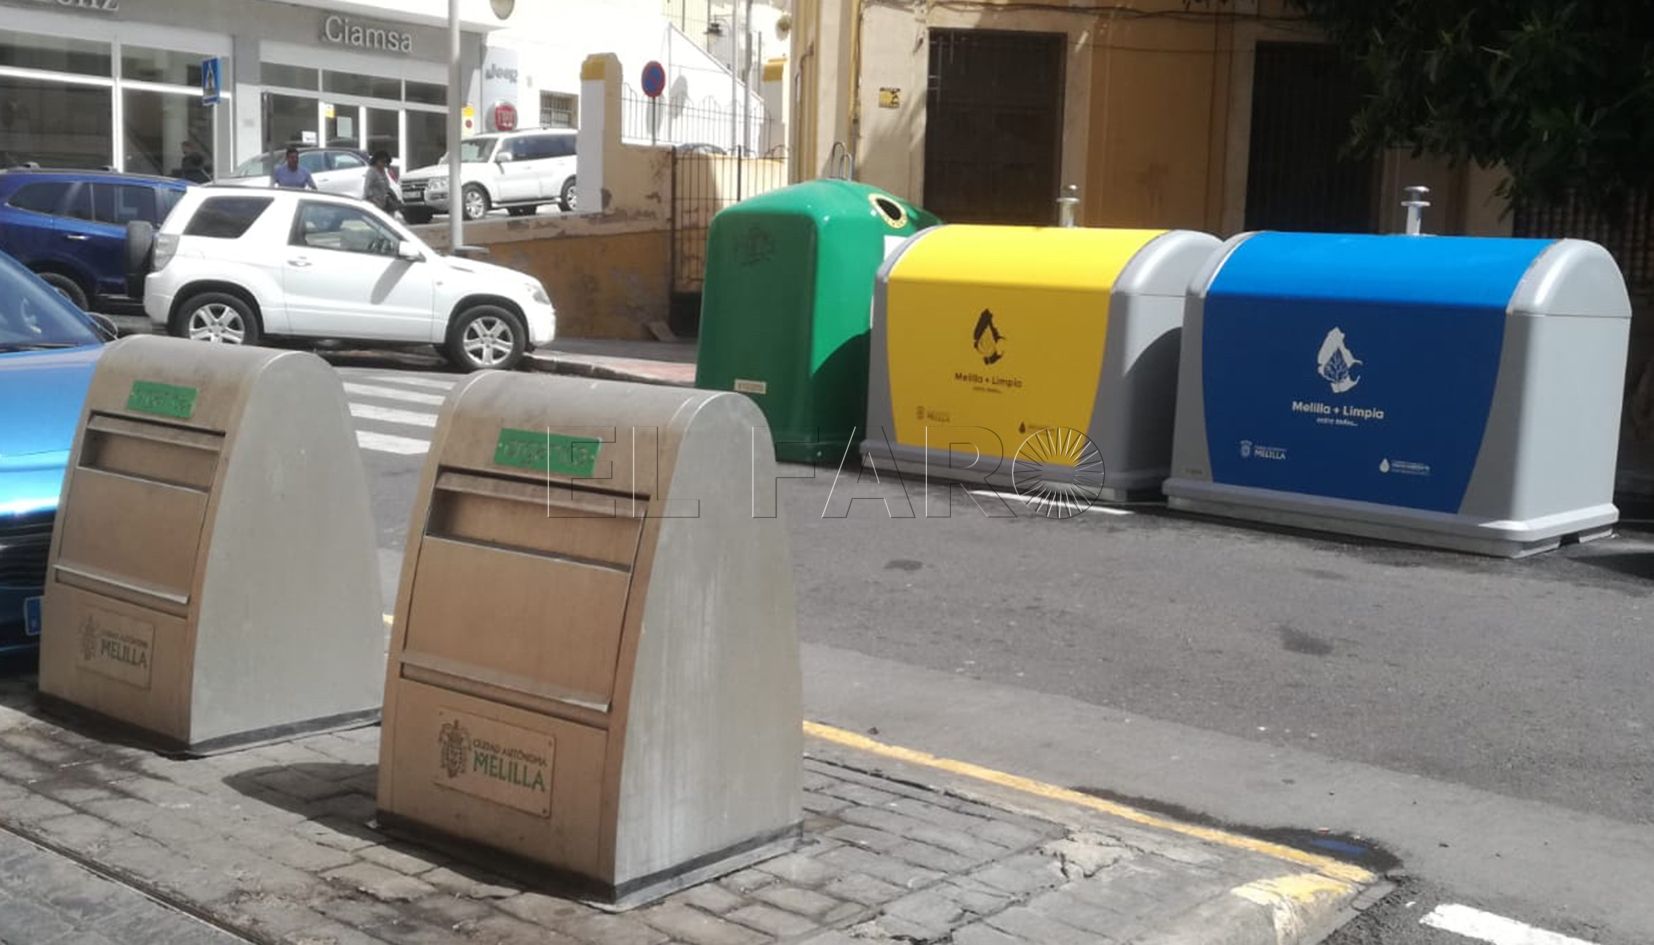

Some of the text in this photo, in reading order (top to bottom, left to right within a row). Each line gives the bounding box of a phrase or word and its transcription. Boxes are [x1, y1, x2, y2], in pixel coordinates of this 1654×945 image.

[325, 15, 413, 53] Ciamsa
[1292, 401, 1331, 414] Melilla
[1343, 405, 1385, 420] Limpia
[1254, 449, 1287, 461] MELILLA
[101, 638, 148, 669] MELILLA
[473, 749, 546, 793] MELILLA
